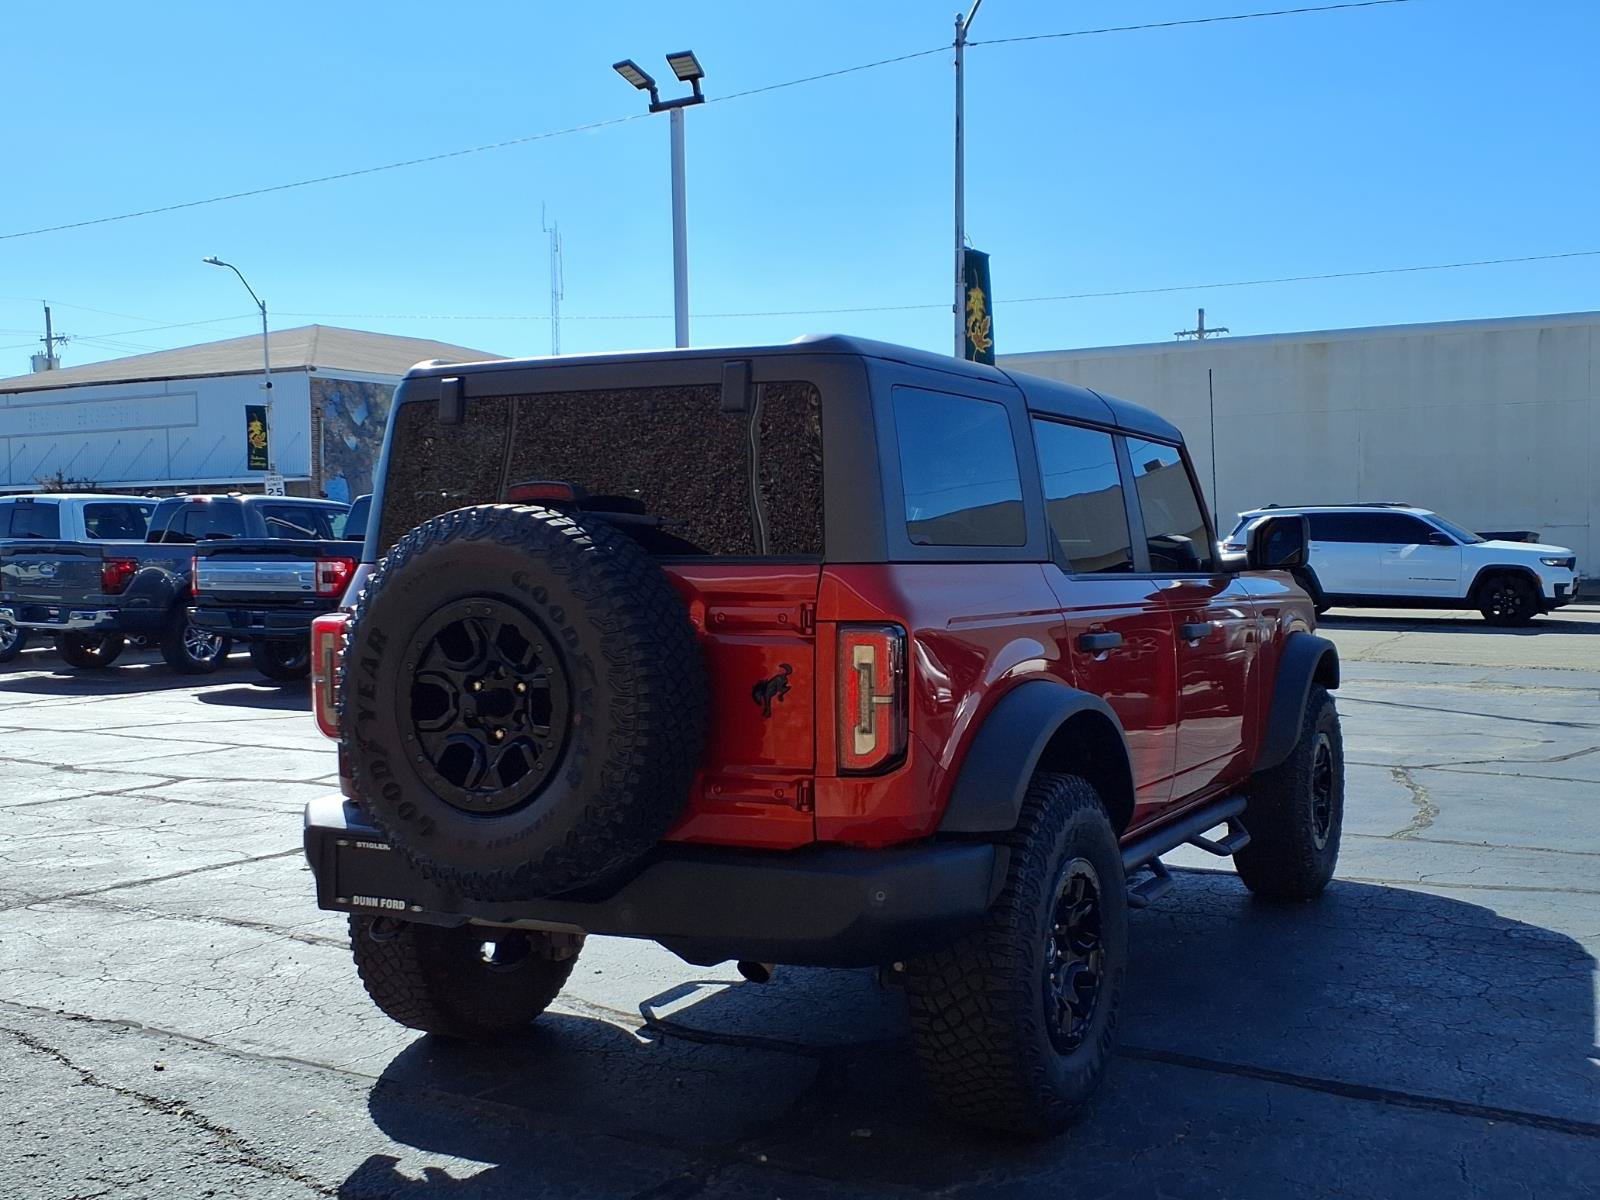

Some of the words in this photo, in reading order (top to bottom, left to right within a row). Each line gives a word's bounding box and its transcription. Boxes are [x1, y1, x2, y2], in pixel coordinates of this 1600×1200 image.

[267, 487, 283, 496] 25
[356, 626, 437, 836] GOODYEAR
[352, 895, 379, 908] DUNN
[380, 898, 406, 910] FORD
